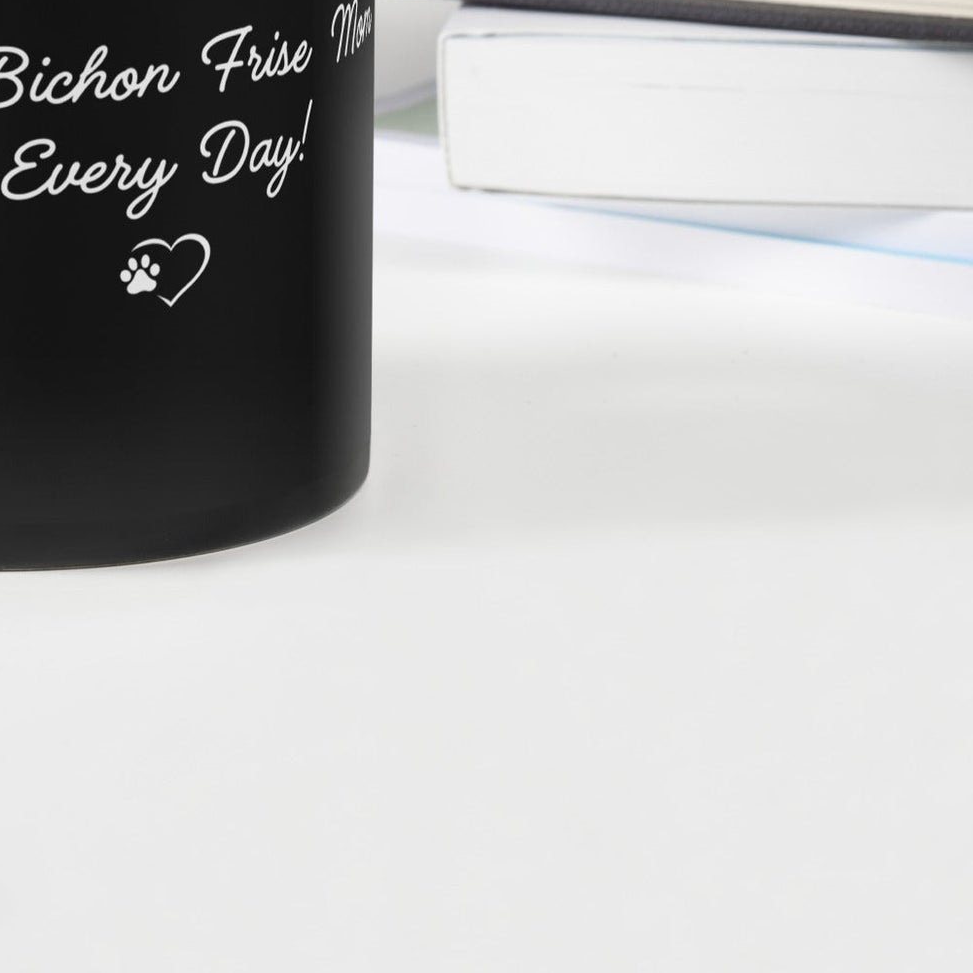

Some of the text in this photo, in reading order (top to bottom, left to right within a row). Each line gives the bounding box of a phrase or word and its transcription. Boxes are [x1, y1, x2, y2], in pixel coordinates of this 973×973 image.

[200, 24, 313, 93] Frise
[0, 98, 314, 220] Every Day!
